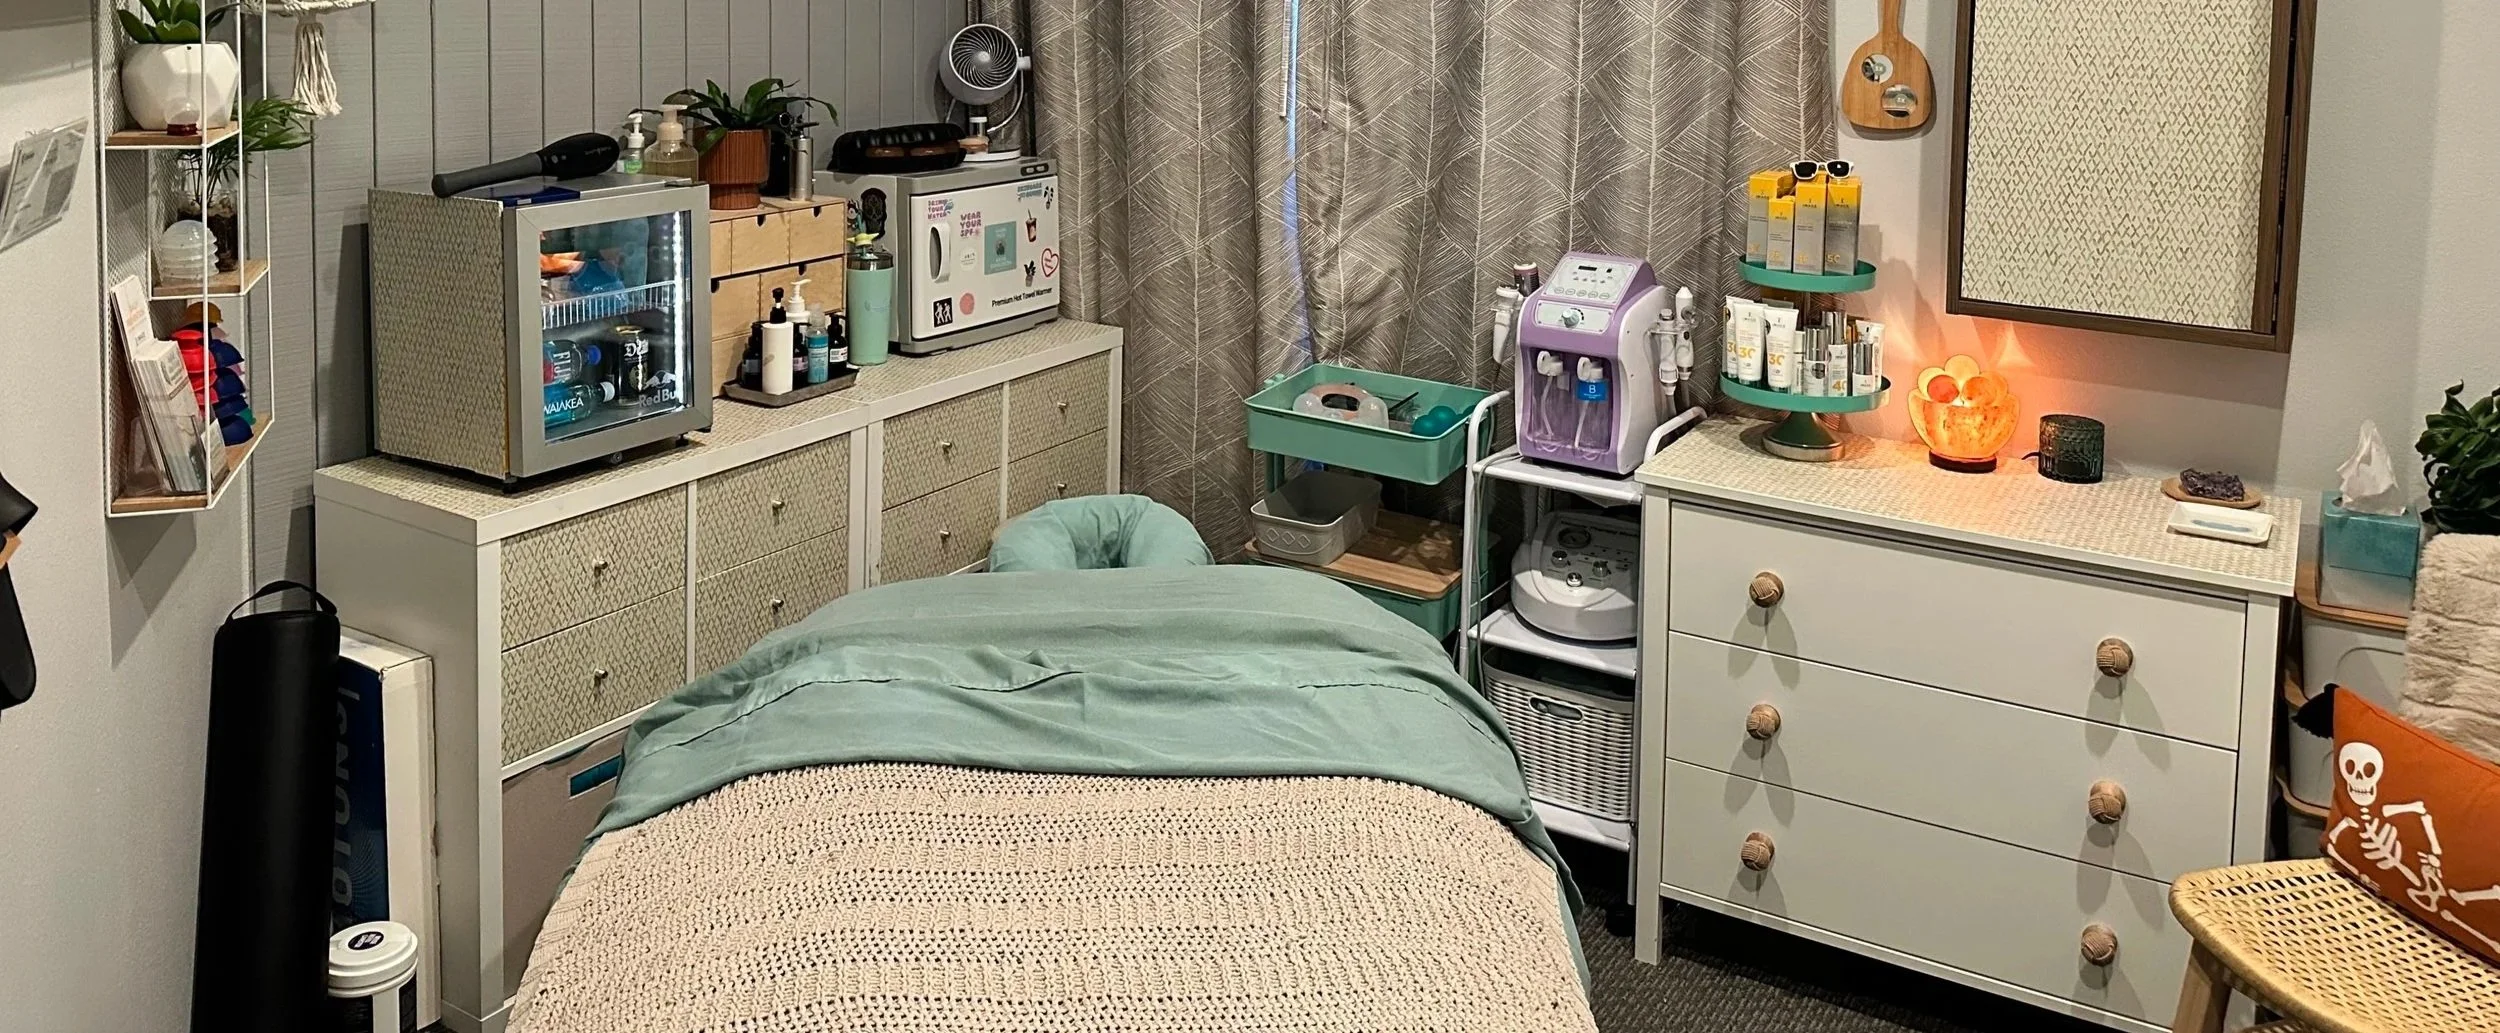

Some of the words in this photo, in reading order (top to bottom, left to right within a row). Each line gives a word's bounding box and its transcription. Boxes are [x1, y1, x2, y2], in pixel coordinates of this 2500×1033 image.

[960, 211, 981, 221] WEAR
[960, 219, 981, 229] YOUR
[960, 228, 974, 237] SPF
[1588, 384, 1597, 394] B
[639, 389, 661, 408] Red
